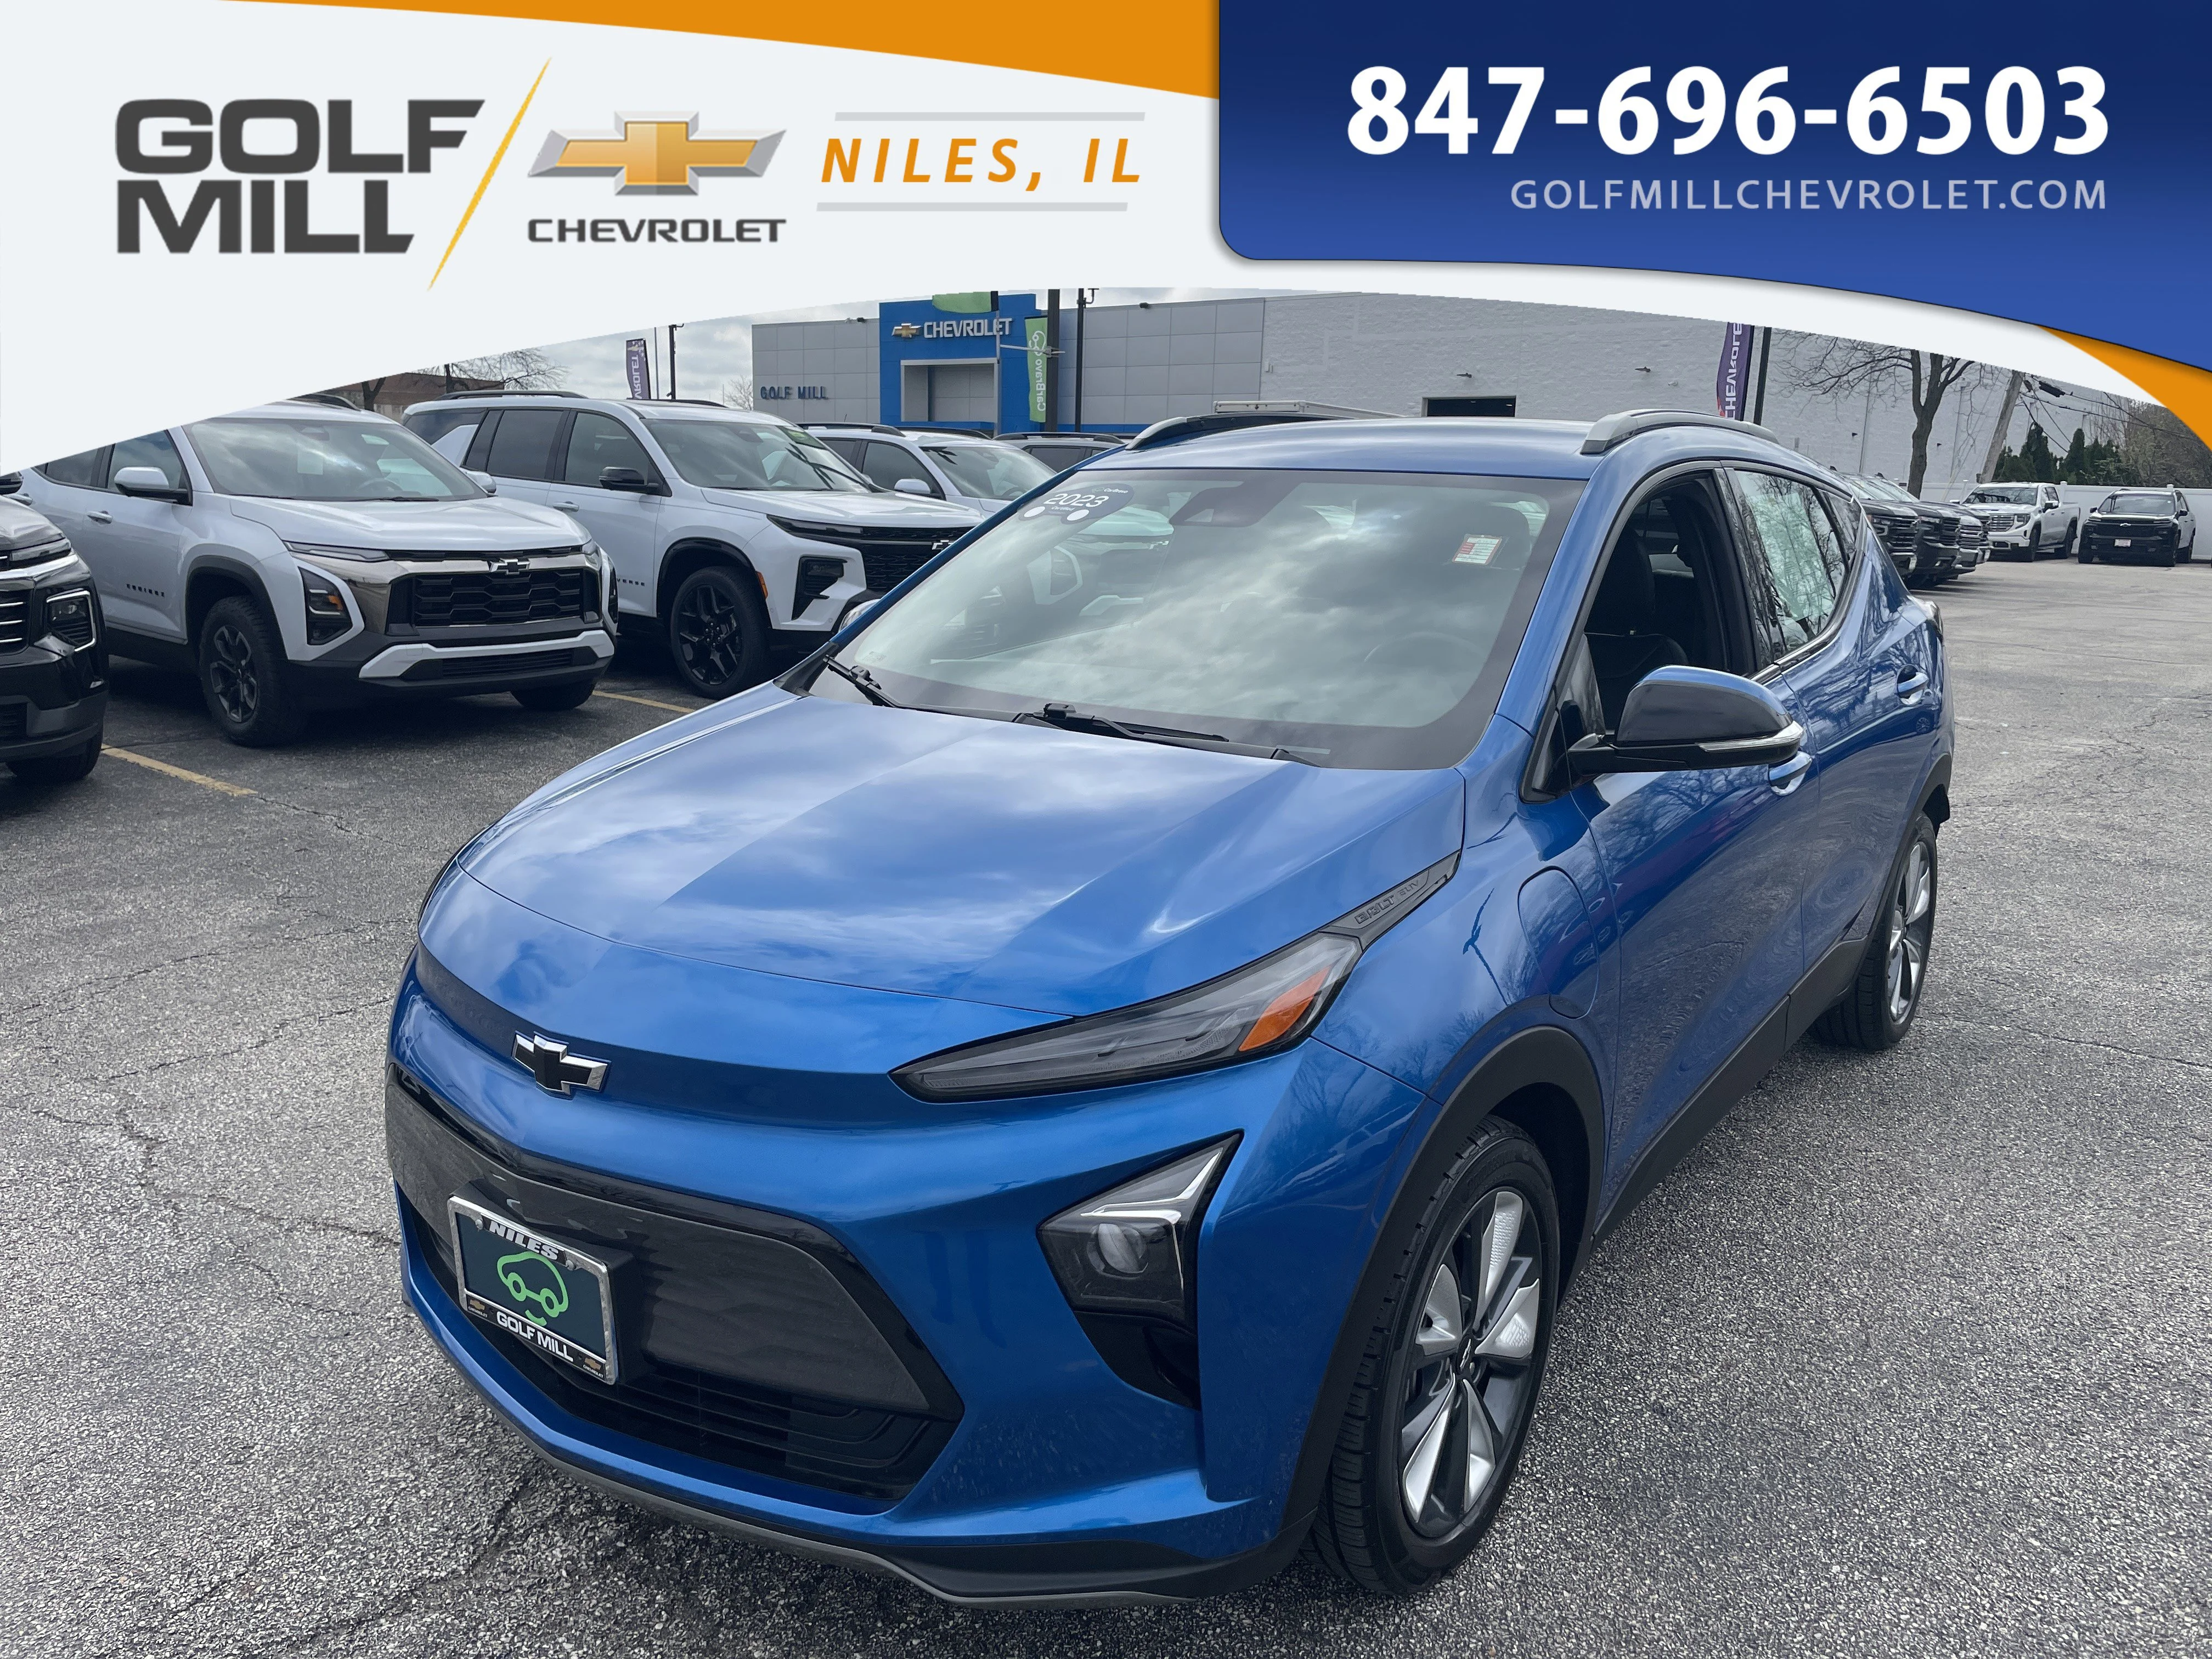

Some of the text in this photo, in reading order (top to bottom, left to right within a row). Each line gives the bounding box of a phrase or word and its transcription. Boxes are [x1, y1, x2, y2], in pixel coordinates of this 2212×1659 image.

[924, 318, 1012, 338] CHEVROLET
[760, 386, 826, 399] GOLF MILL
[1043, 493, 1109, 507] 2023
[489, 1220, 560, 1261] NILES
[496, 1311, 574, 1363] GOLF MILL
